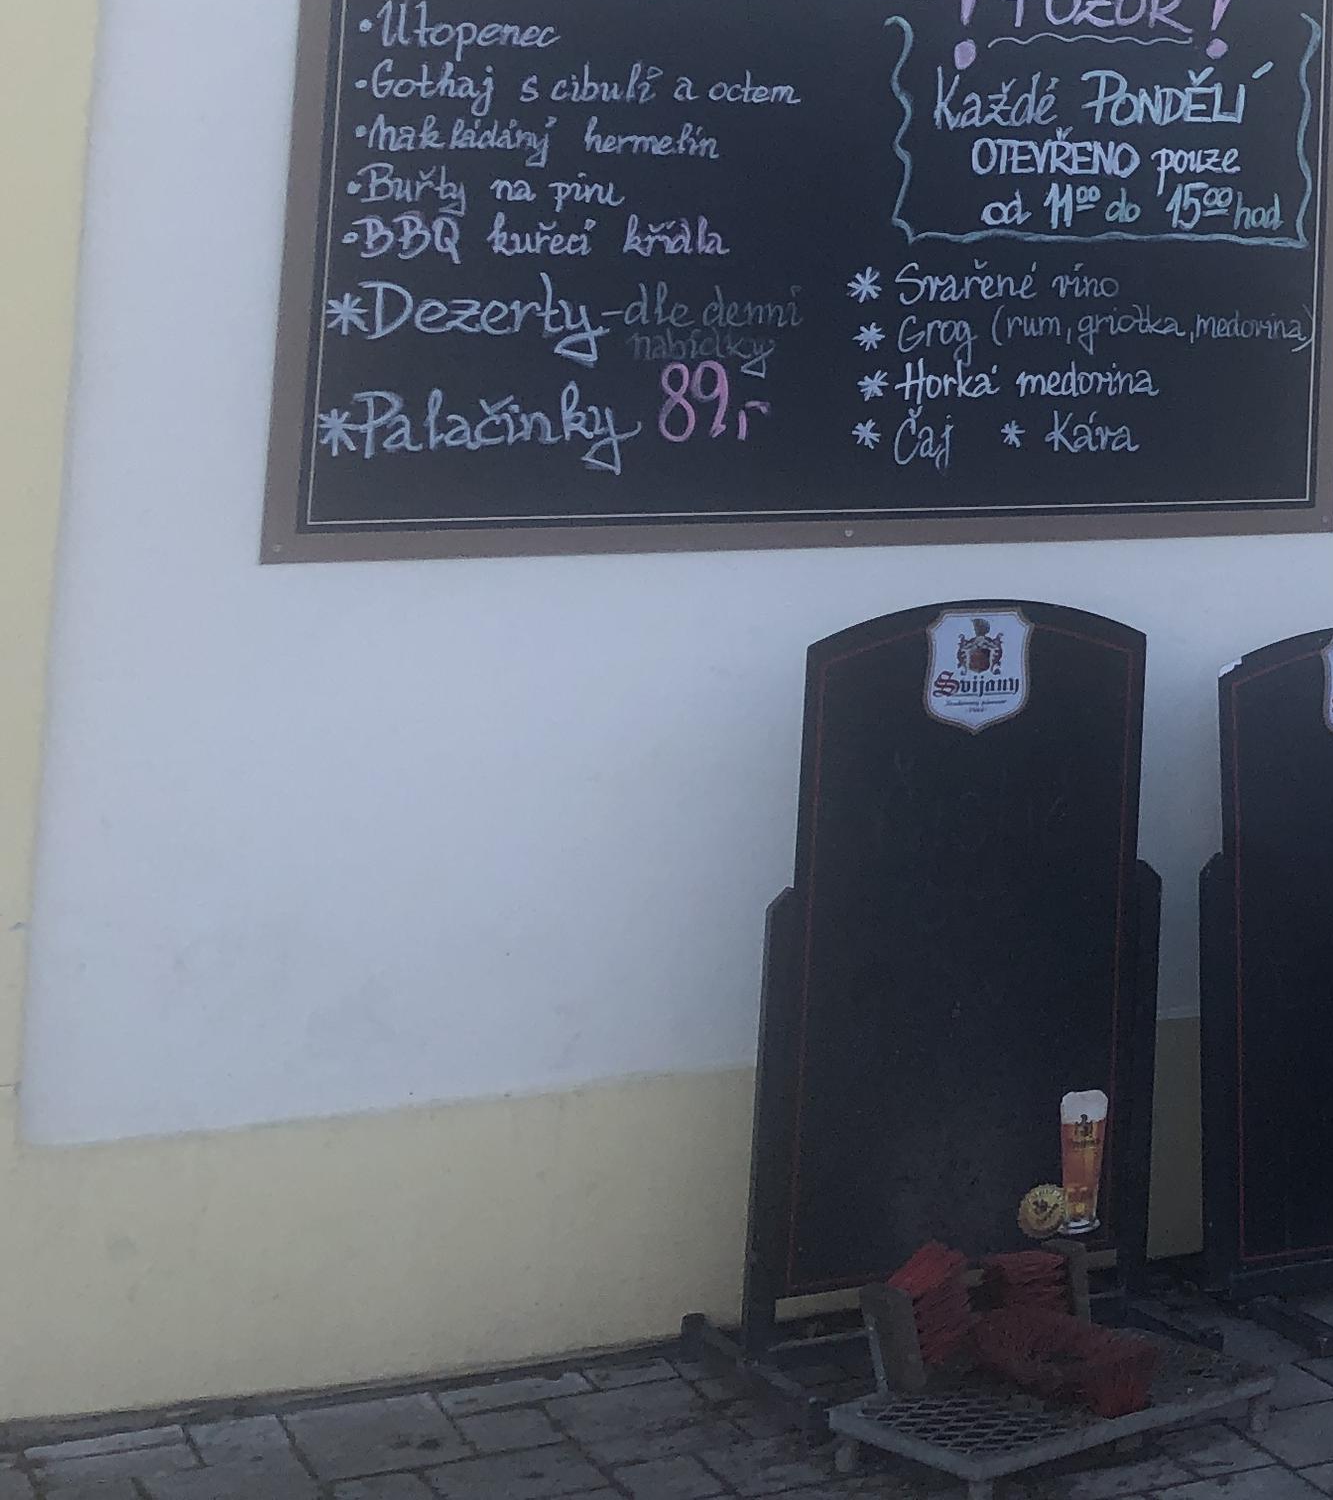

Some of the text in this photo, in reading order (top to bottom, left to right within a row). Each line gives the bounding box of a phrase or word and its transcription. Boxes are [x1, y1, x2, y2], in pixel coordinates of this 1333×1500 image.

[378, 0, 562, 61] Utopenec
[371, 58, 804, 116] Gothaj s cibulí a octem
[585, 114, 722, 160] hermelín
[971, 126, 1242, 198] OTEVŘENO pouze
[488, 175, 535, 203] na
[980, 188, 1034, 227] od
[1104, 188, 1141, 224] do
[354, 208, 461, 265] BBQ
[485, 211, 595, 258] kuřecí
[894, 259, 1120, 306] Svařené víno
[358, 271, 610, 368] Dezerty
[897, 315, 979, 367] Grog
[893, 358, 1161, 405] Horká medovina
[893, 405, 1142, 472] Čaj Káva
[931, 670, 1020, 698] Svijany
